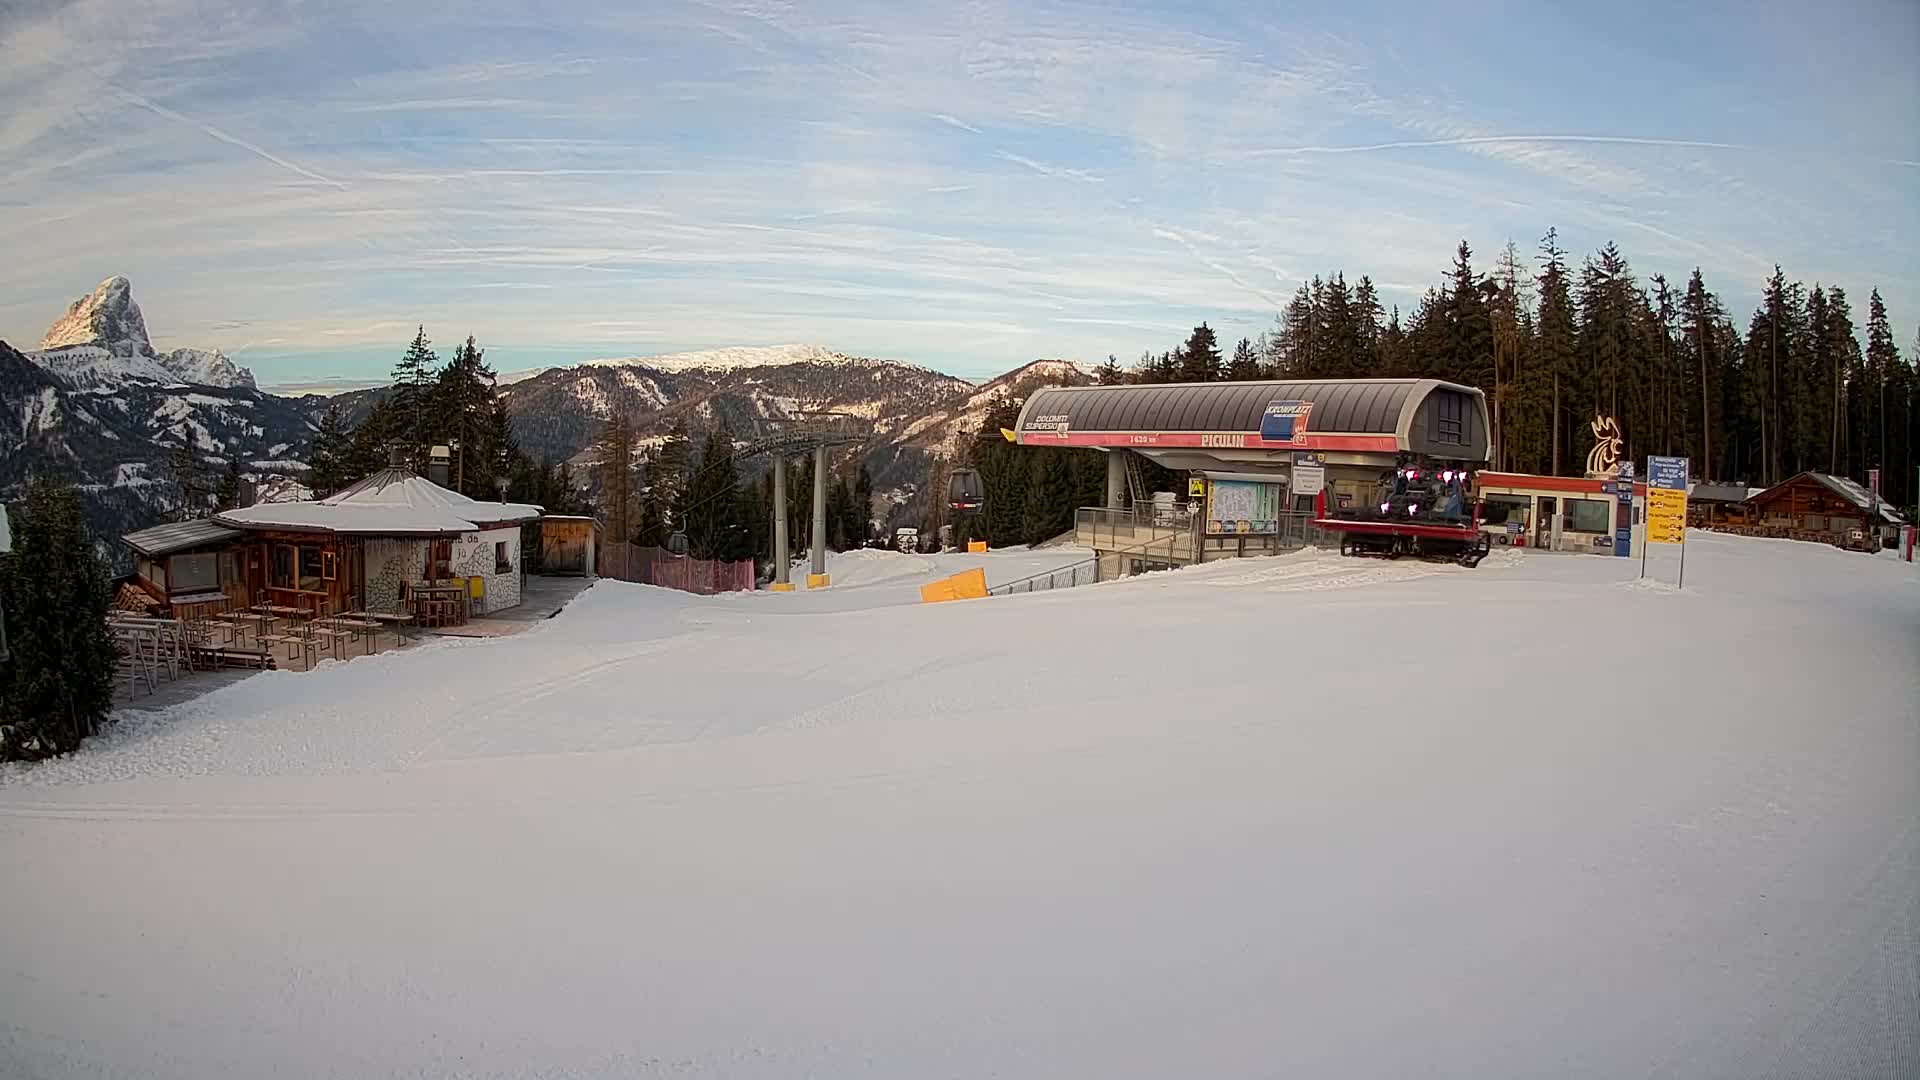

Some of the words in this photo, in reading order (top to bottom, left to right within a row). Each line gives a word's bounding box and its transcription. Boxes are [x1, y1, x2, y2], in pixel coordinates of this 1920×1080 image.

[1035, 415, 1068, 423] DOLOMITI
[1024, 422, 1058, 430] SUPERSKI
[1201, 434, 1245, 448] PICULIN
